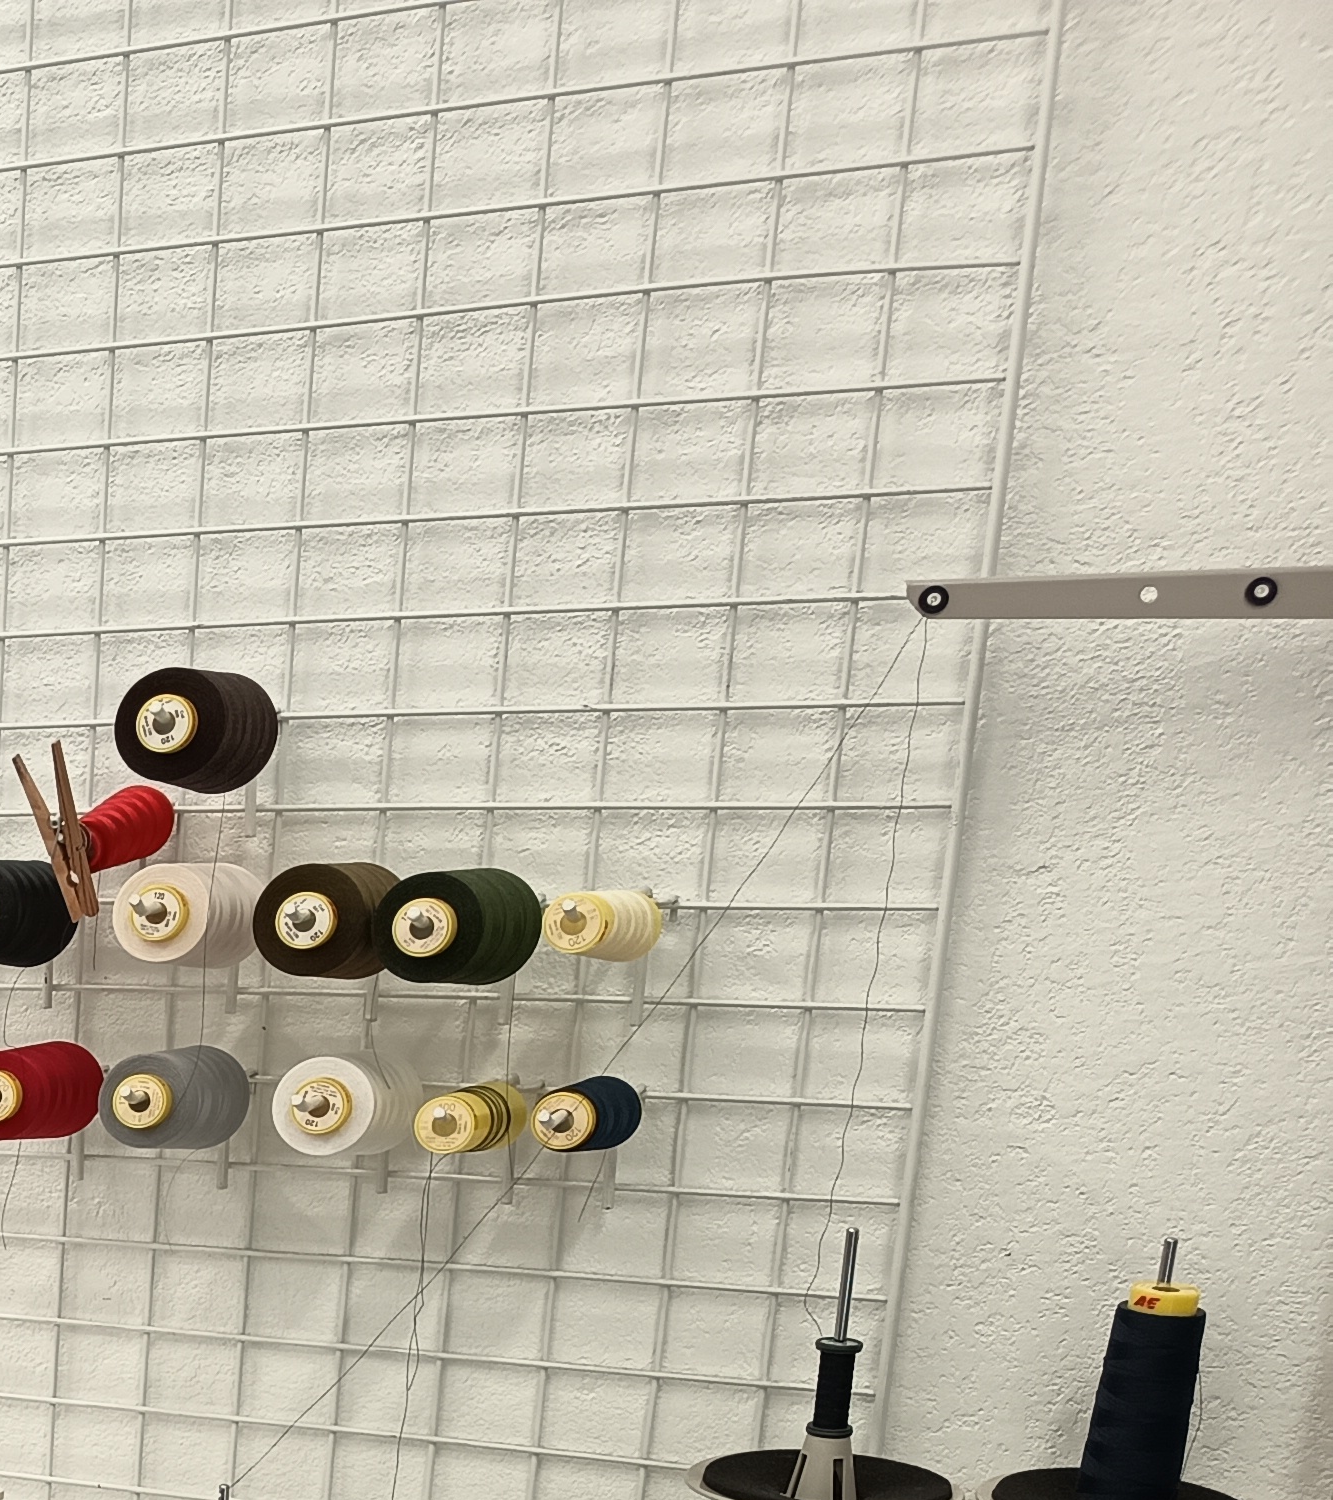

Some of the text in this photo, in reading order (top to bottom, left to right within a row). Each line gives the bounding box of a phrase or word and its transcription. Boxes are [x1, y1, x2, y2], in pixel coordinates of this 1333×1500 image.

[161, 736, 174, 746] 120
[310, 929, 323, 942] 120
[569, 934, 587, 947] 120
[305, 1117, 319, 1128] 120
